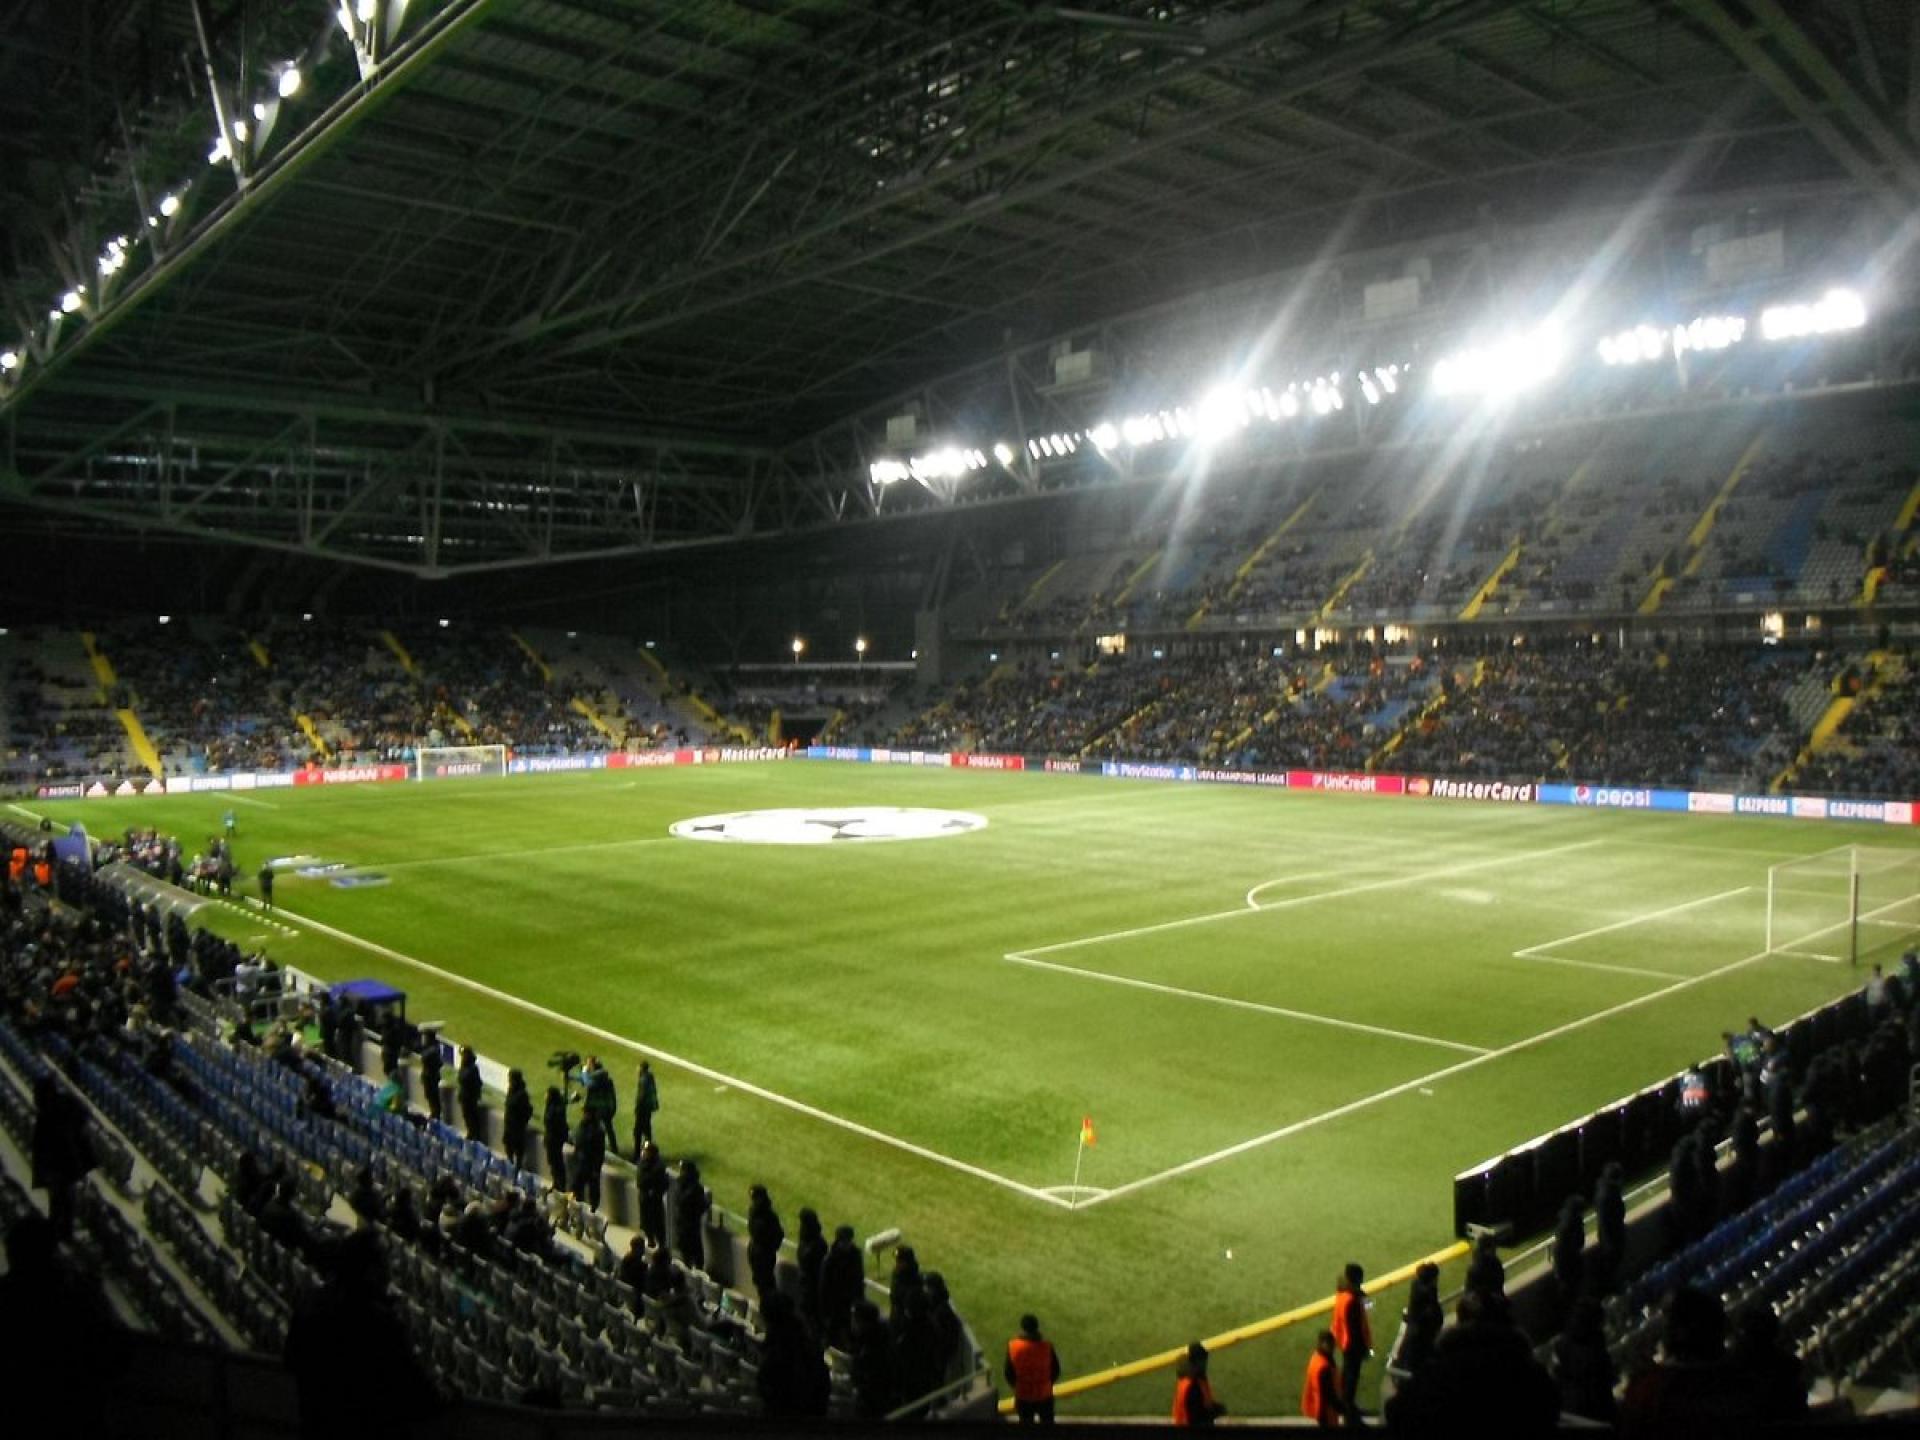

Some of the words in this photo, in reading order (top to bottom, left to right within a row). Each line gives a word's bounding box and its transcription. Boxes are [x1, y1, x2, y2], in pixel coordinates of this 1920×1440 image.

[719, 747, 787, 763] MasterCard
[322, 768, 377, 782] NISSAN
[1120, 764, 1176, 779] PlayStation
[1257, 773, 1285, 785] LEAGUE
[1323, 776, 1376, 791] UniCredit
[1431, 779, 1531, 801] MasterCard
[1595, 788, 1650, 808] pepsi
[1738, 796, 1788, 814] GAZPROM
[1830, 802, 1884, 819] GAZPROM
